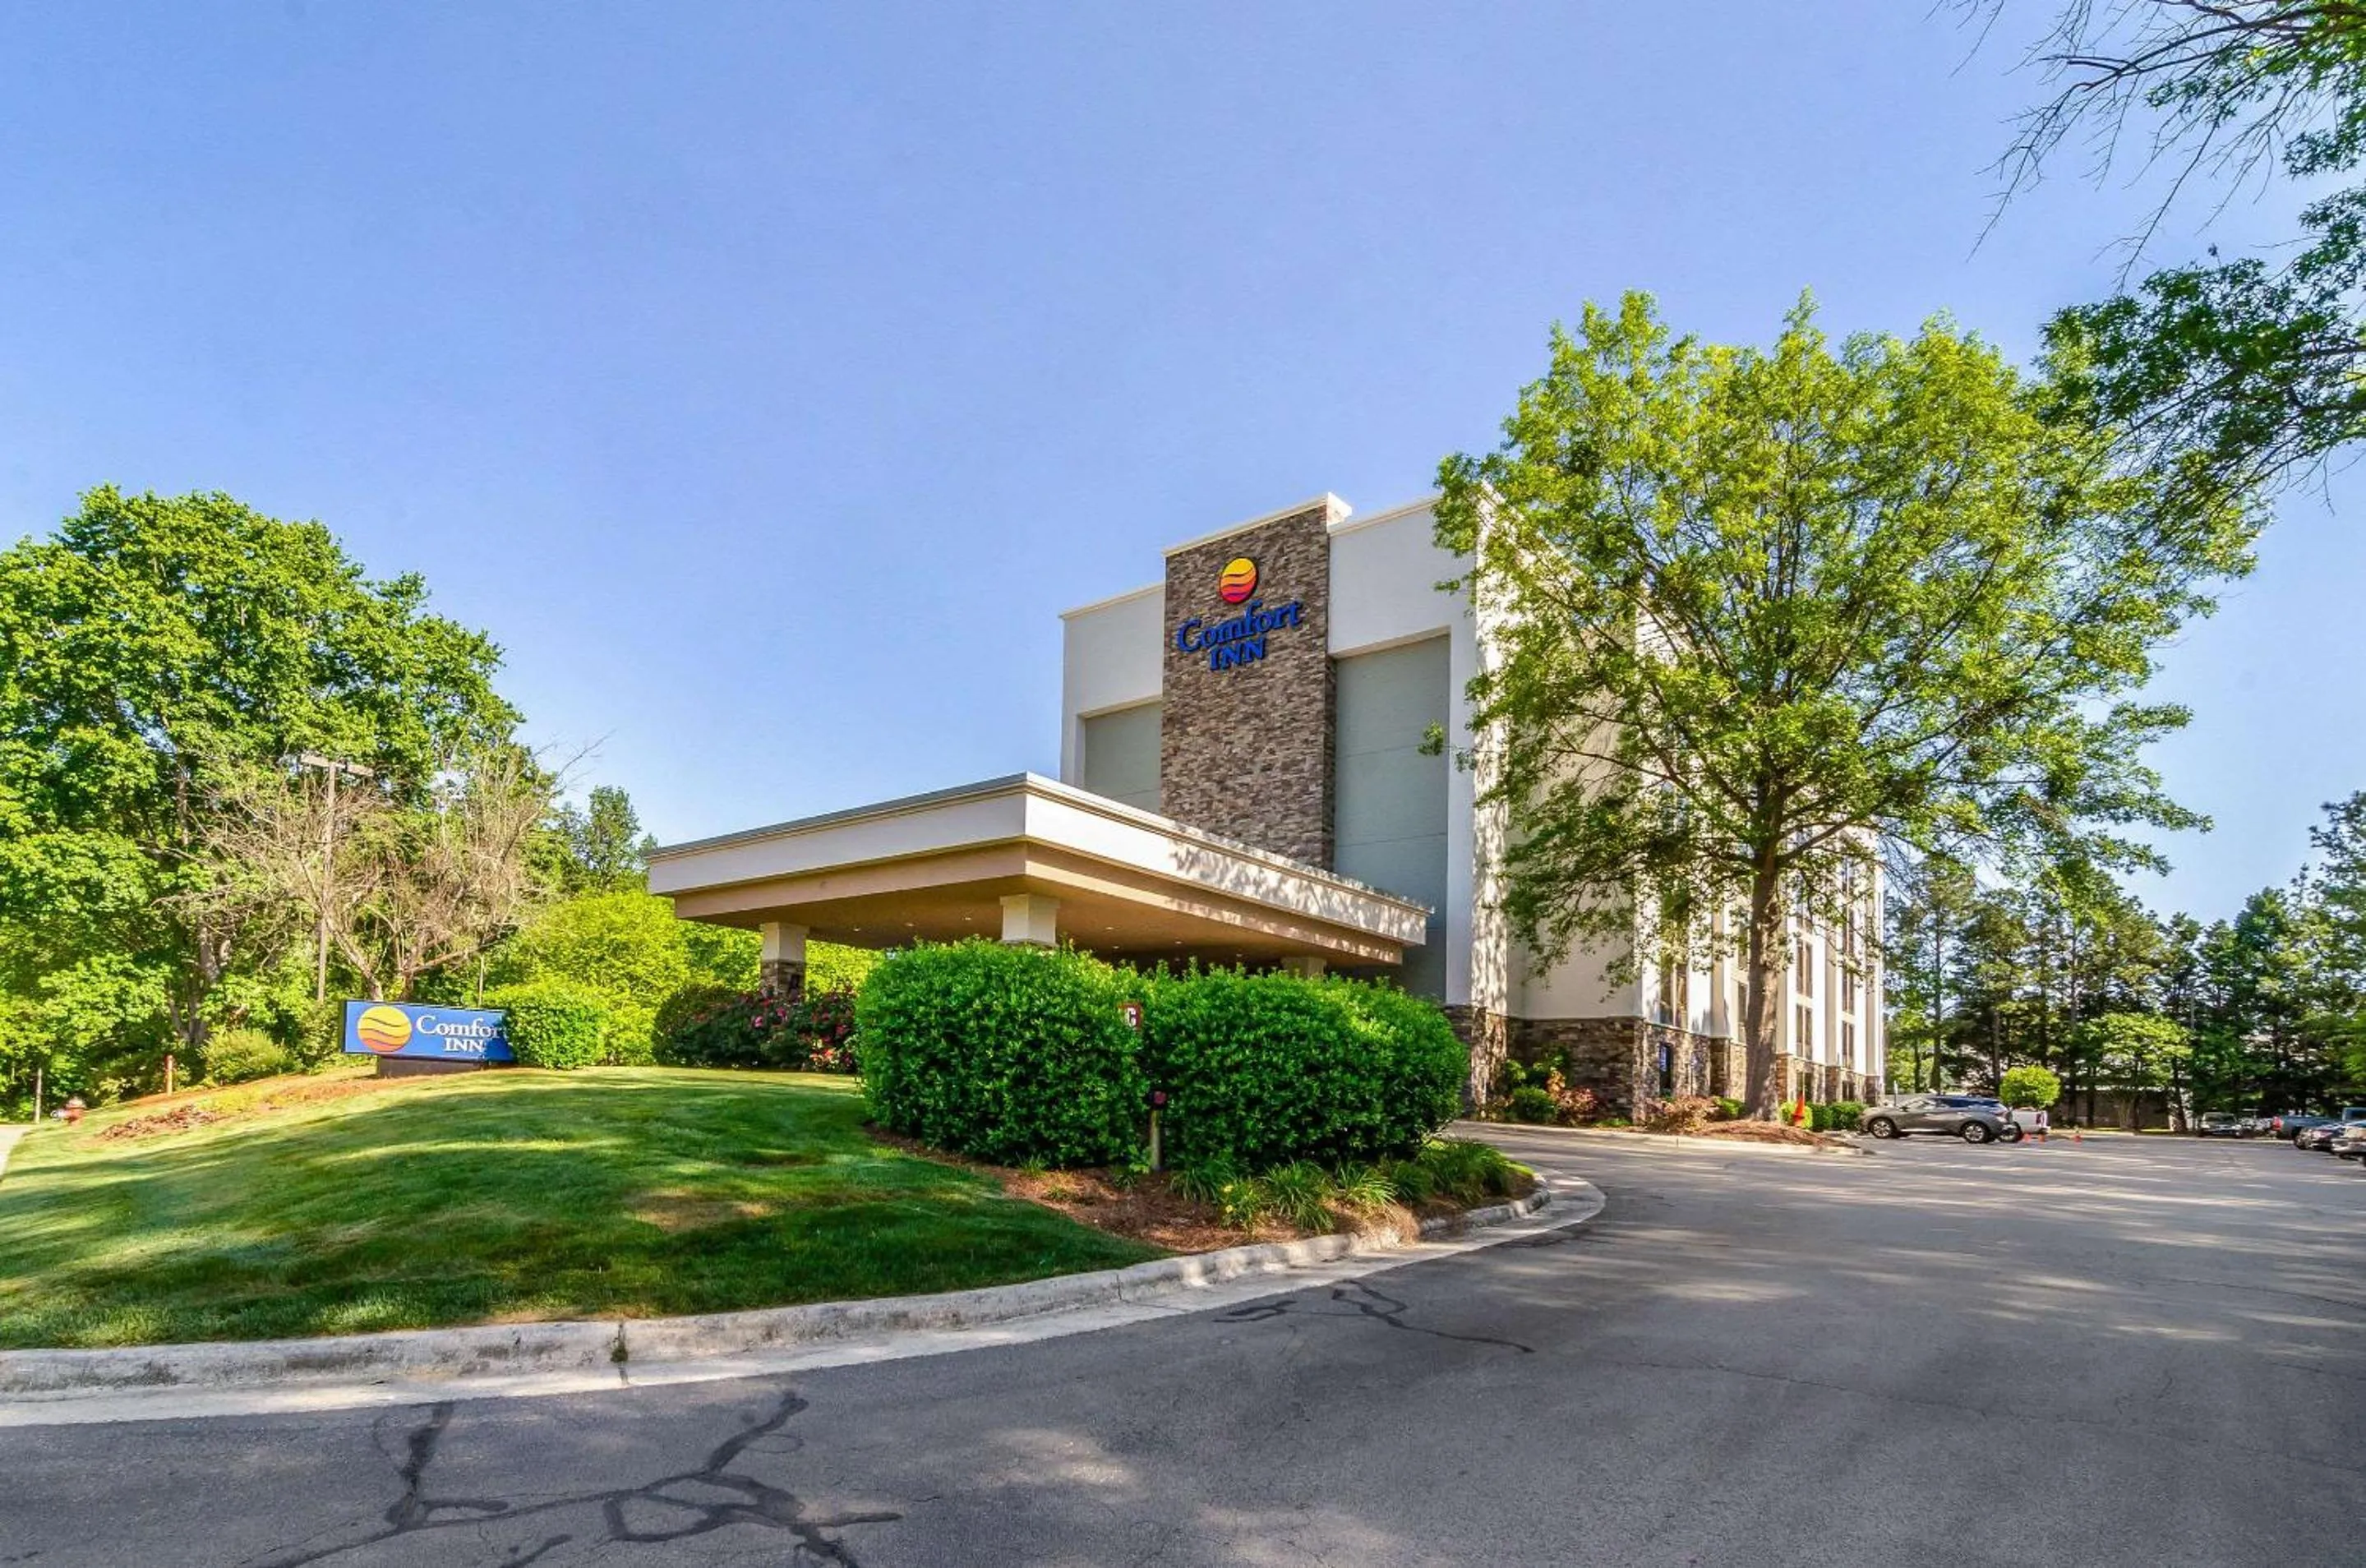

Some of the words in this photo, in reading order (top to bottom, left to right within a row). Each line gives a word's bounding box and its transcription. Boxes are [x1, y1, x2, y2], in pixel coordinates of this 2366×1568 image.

[1177, 599, 1303, 652] Comfort
[1209, 638, 1266, 671] INN
[416, 1015, 504, 1039] Comfor
[445, 1037, 485, 1053] INN
